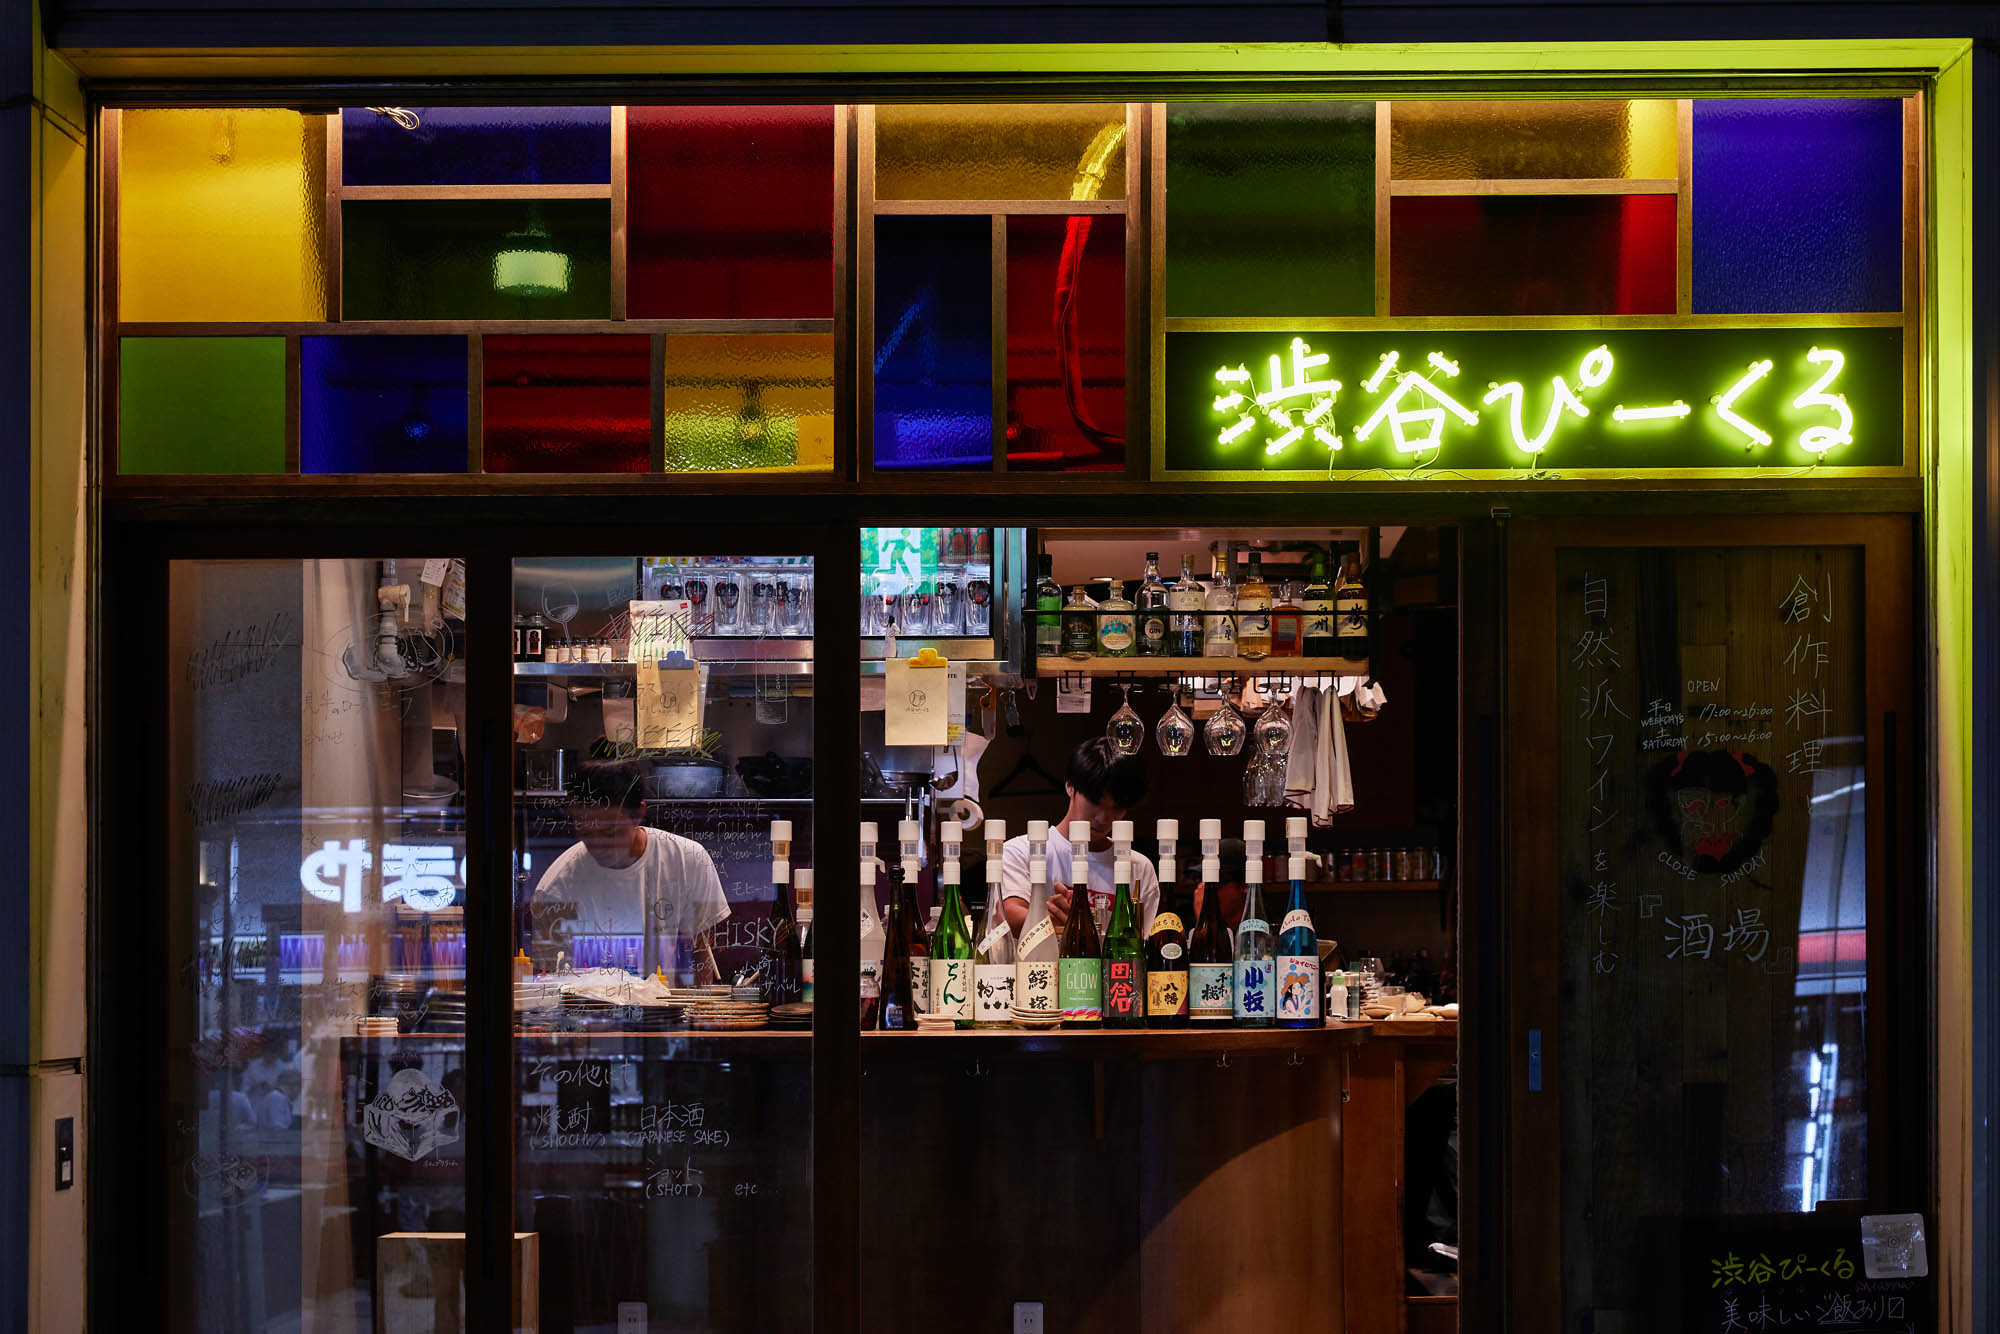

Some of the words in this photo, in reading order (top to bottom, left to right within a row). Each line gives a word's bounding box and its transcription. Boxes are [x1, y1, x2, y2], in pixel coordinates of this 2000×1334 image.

[1213, 337, 1854, 456] 渋谷ぴーくる
[1687, 677, 1720, 694] OPEN
[1573, 570, 1631, 977] 自然派ワインを楽しむ
[1657, 850, 1698, 880] CLOSE
[1719, 848, 1768, 888] SUNDAY
[692, 916, 785, 951] WHISKY
[1066, 972, 1098, 990] GLOW
[1243, 966, 1264, 1013] 小牧
[640, 1099, 706, 1131] 日本酒
[1711, 1247, 1857, 1290] 渋谷ぴーくる
